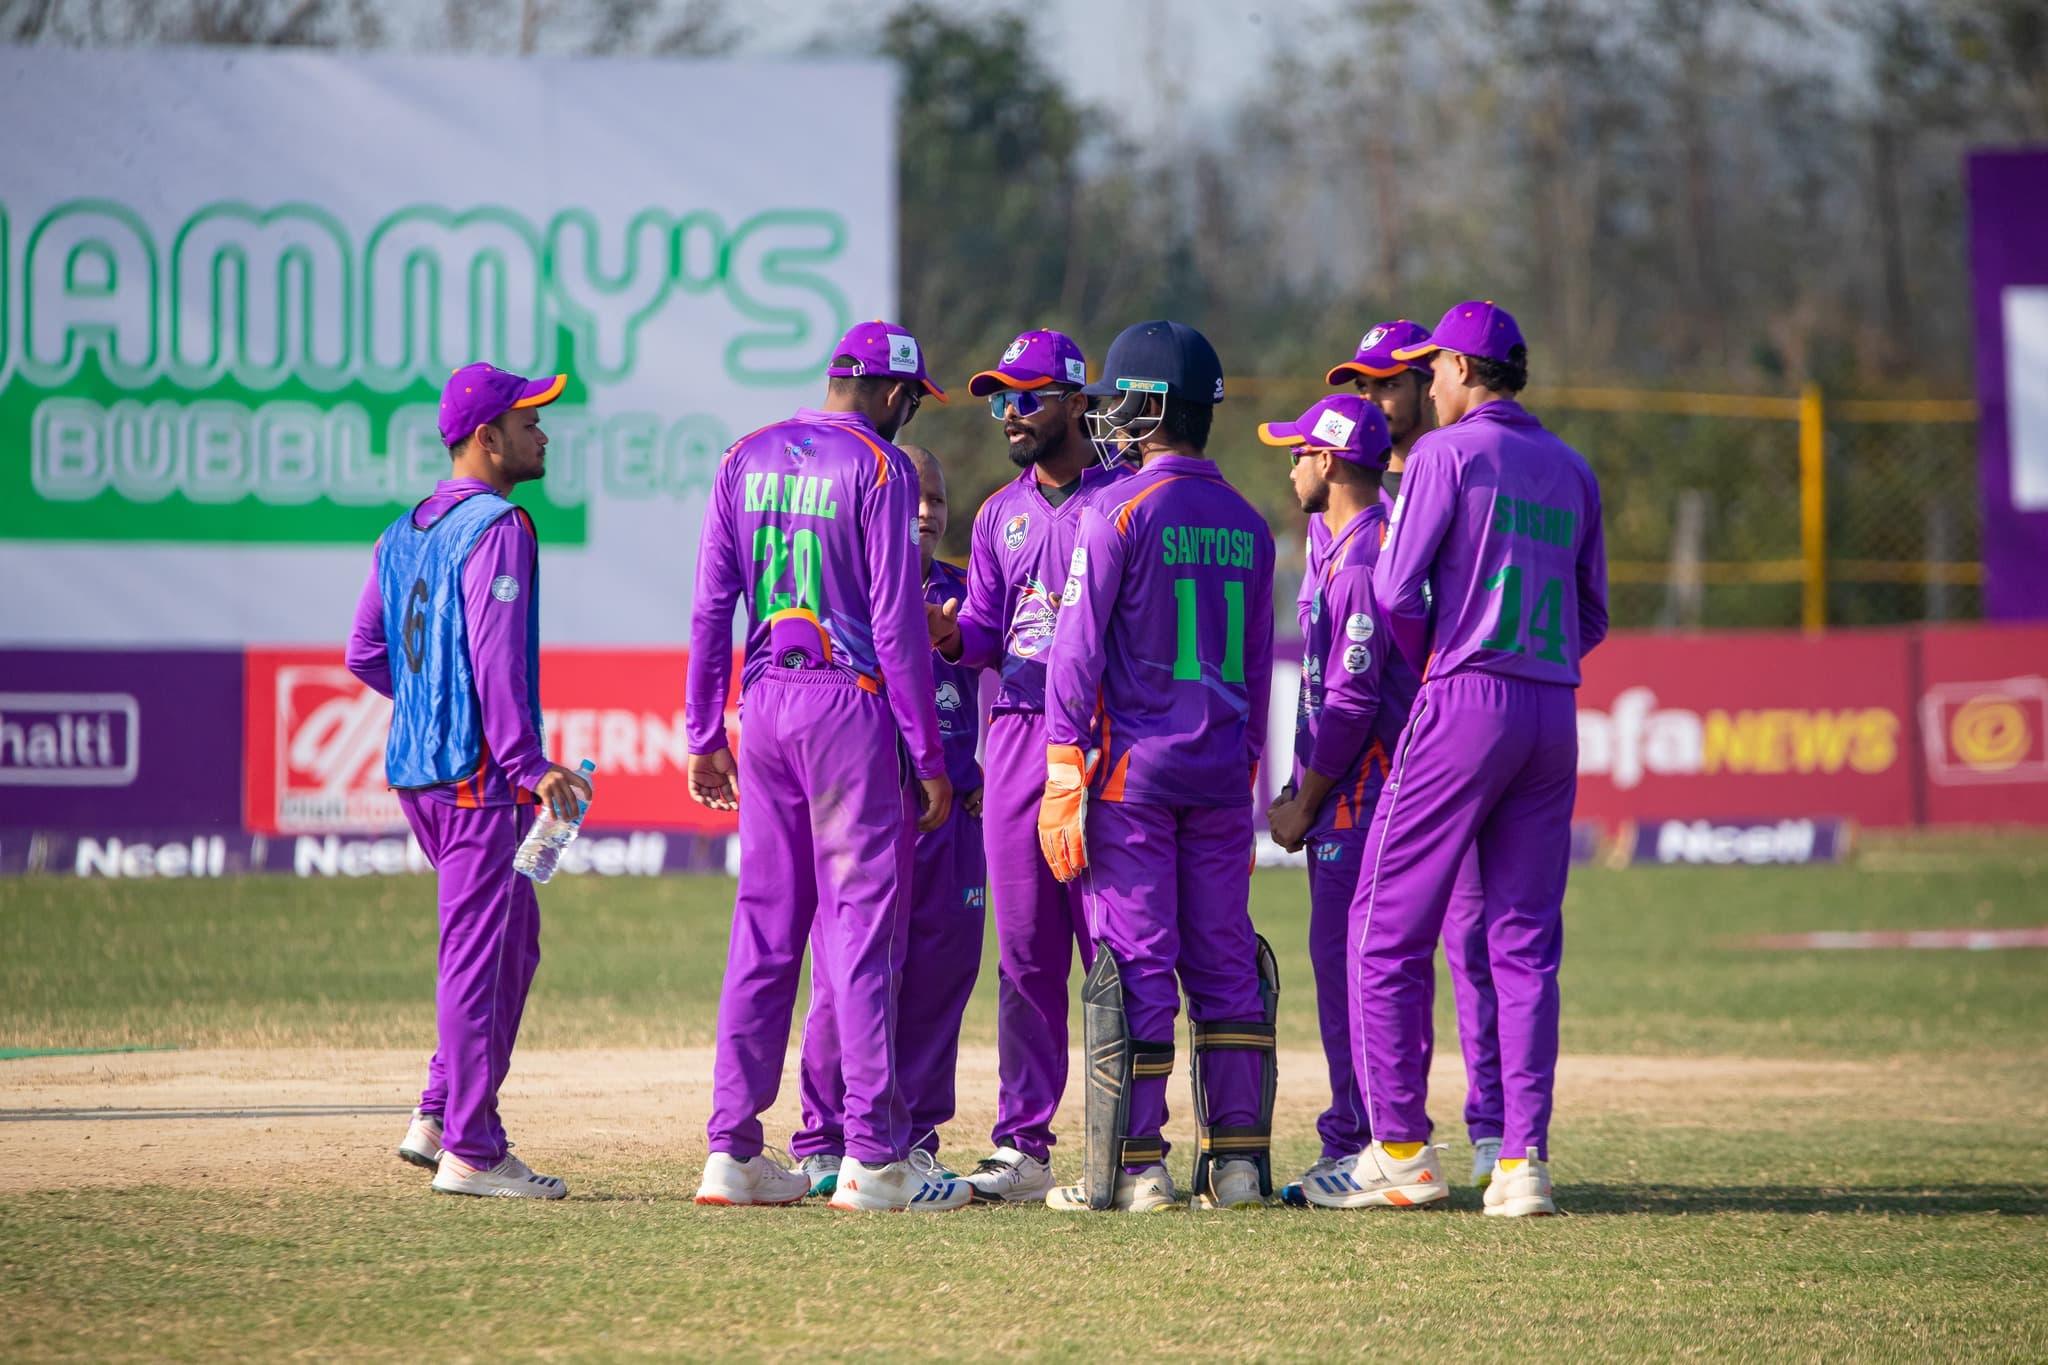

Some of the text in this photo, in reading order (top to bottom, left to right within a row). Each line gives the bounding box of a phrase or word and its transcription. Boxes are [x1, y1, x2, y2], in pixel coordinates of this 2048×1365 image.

[0, 200, 852, 390] AMMY'S
[34, 398, 451, 503] BUBBLE
[752, 525, 823, 622] 20
[1162, 526, 1255, 570] SANTOSH
[403, 578, 428, 674] 6
[1172, 578, 1246, 683] 11
[1481, 565, 1568, 665] 14
[75, 835, 226, 878] Ncell
[295, 833, 432, 878] Ncel
[556, 830, 667, 877] cell
[1657, 818, 1814, 864] Ncell
